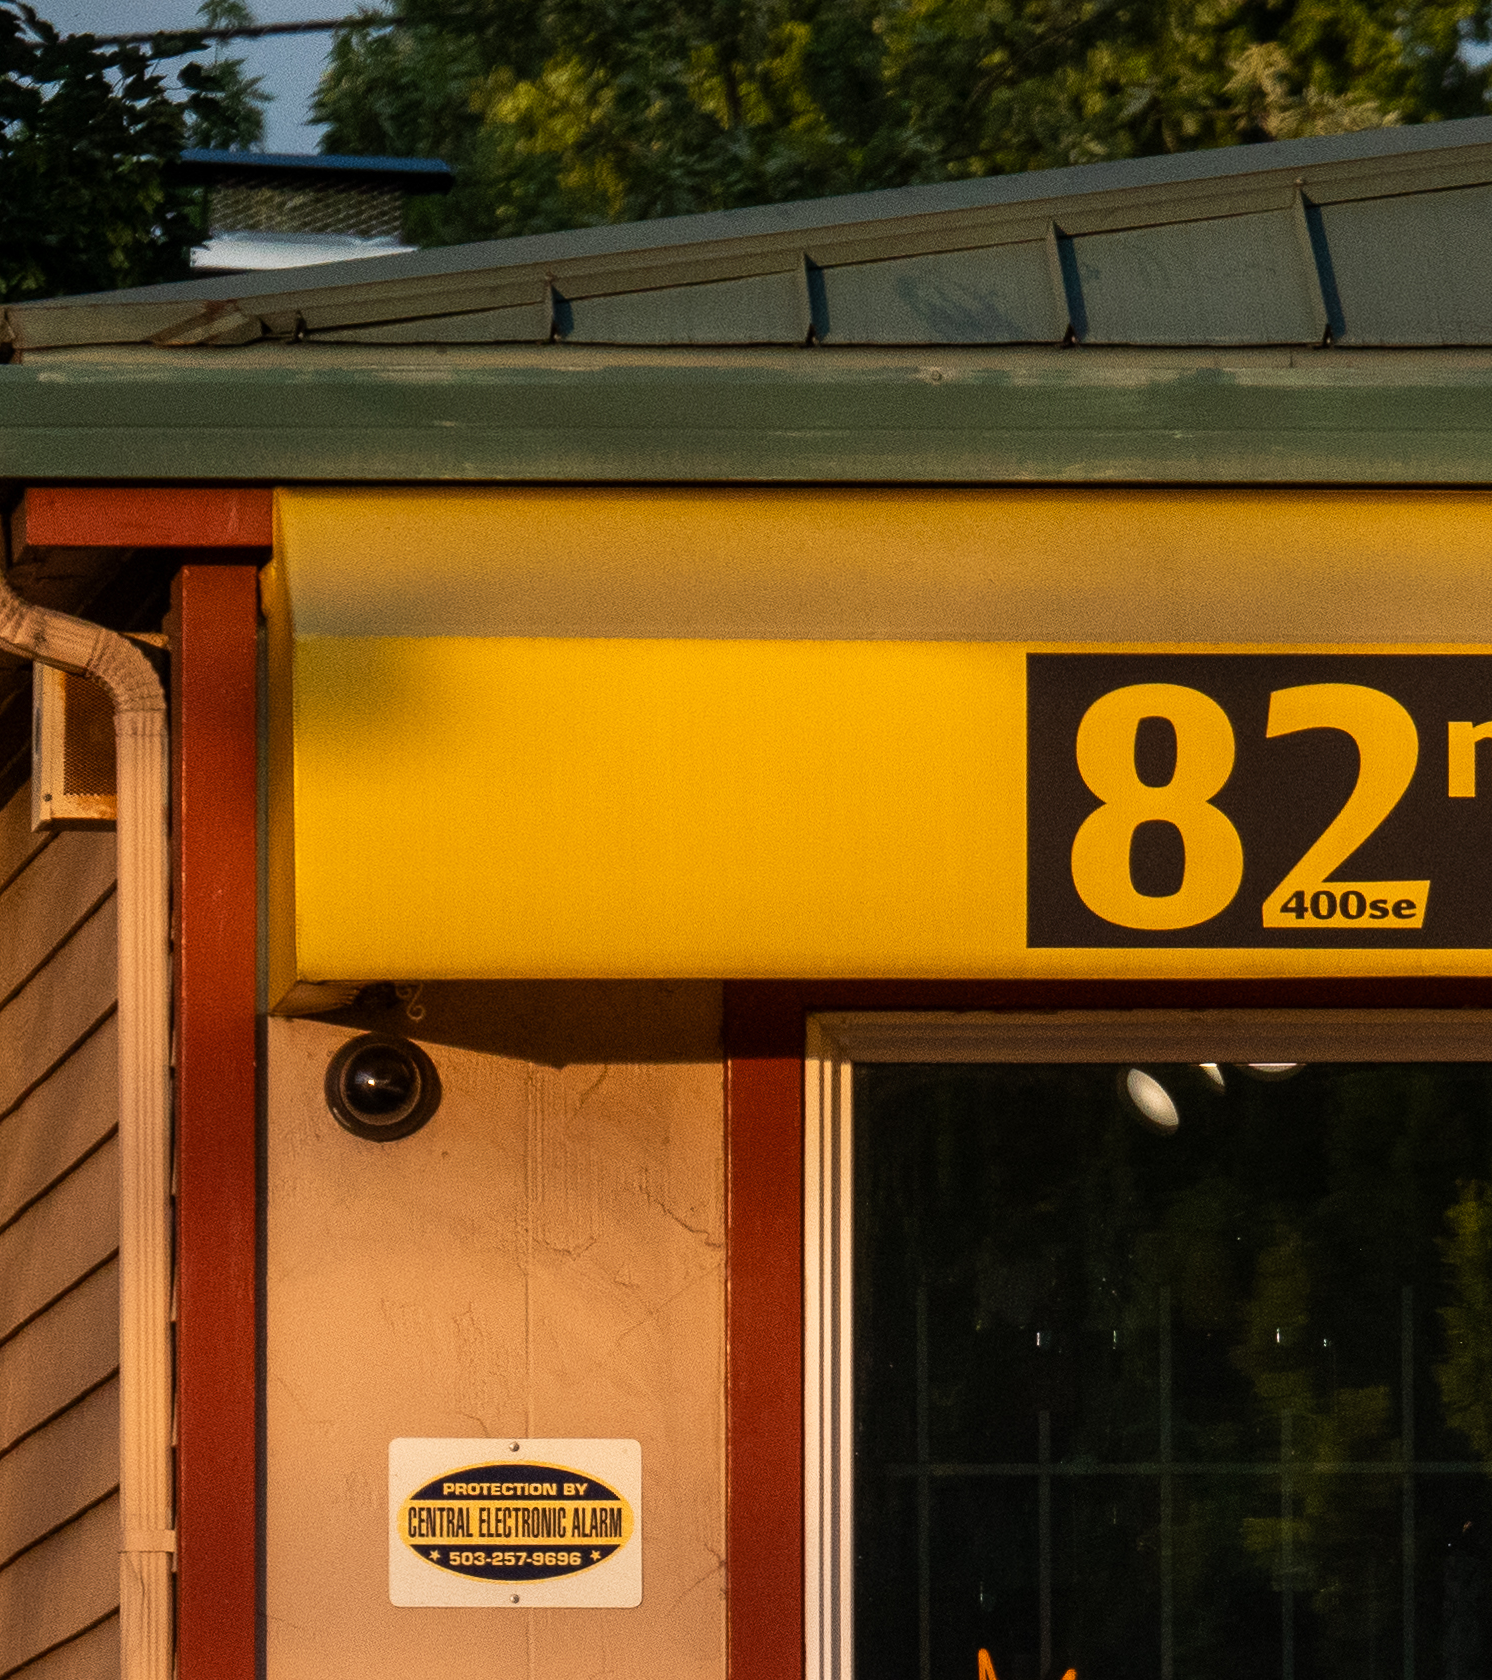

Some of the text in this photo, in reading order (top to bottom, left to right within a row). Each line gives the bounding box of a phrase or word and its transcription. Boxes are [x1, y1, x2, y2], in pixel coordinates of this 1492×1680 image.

[1279, 889, 1418, 921] 400se
[443, 1482, 589, 1496] PROTECTION BY
[407, 1507, 623, 1538] CENTRAL ELECTRONIC ALARM
[449, 1552, 582, 1566] 503-257-9696
